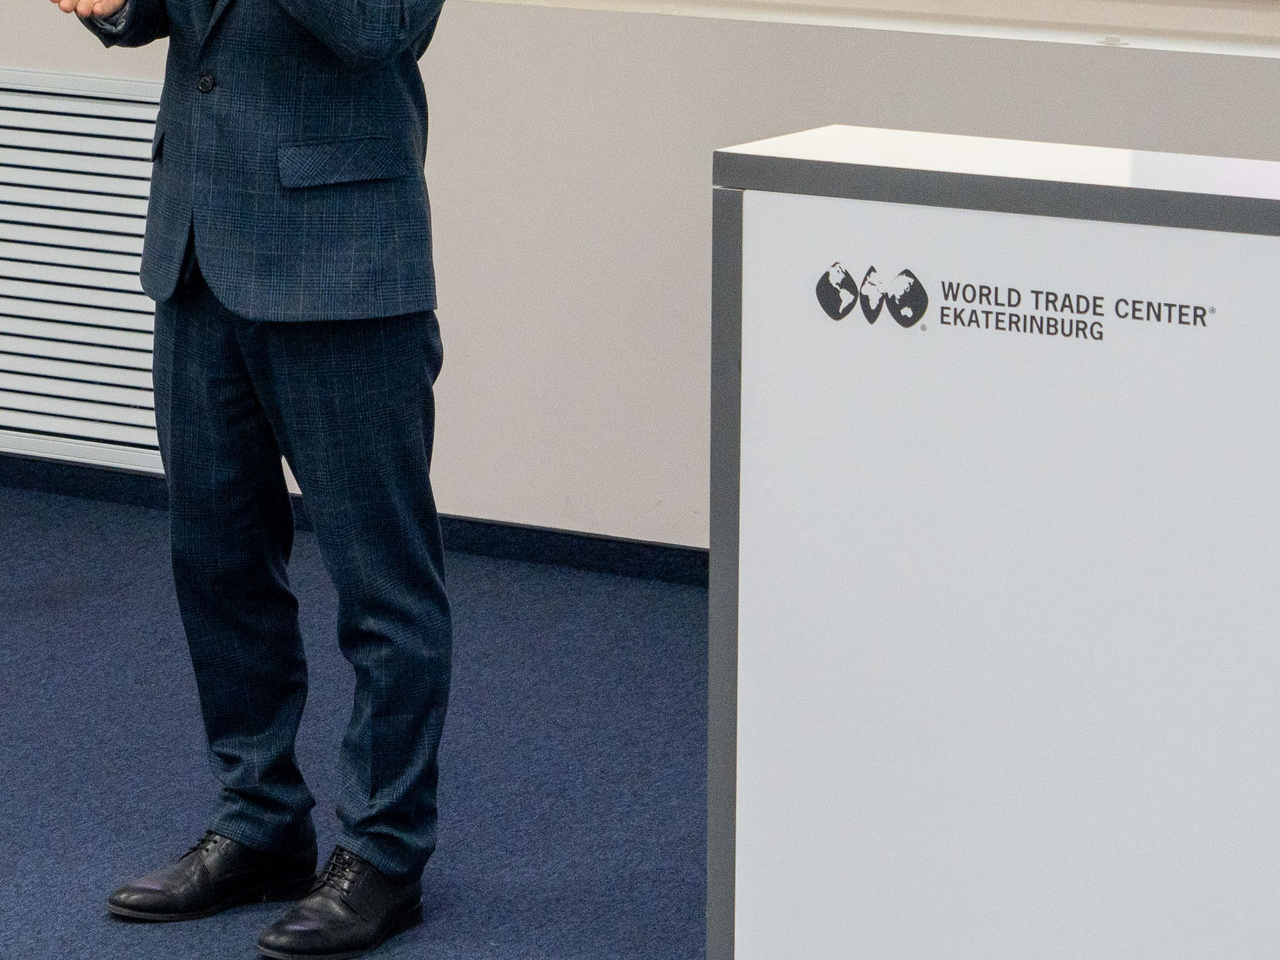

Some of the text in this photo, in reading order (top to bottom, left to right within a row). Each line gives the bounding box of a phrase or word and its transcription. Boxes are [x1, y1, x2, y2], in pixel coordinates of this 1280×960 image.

[940, 281, 1022, 308] WORLD
[1030, 290, 1105, 317] TRADE
[939, 306, 1104, 341] EKATERINBURG
